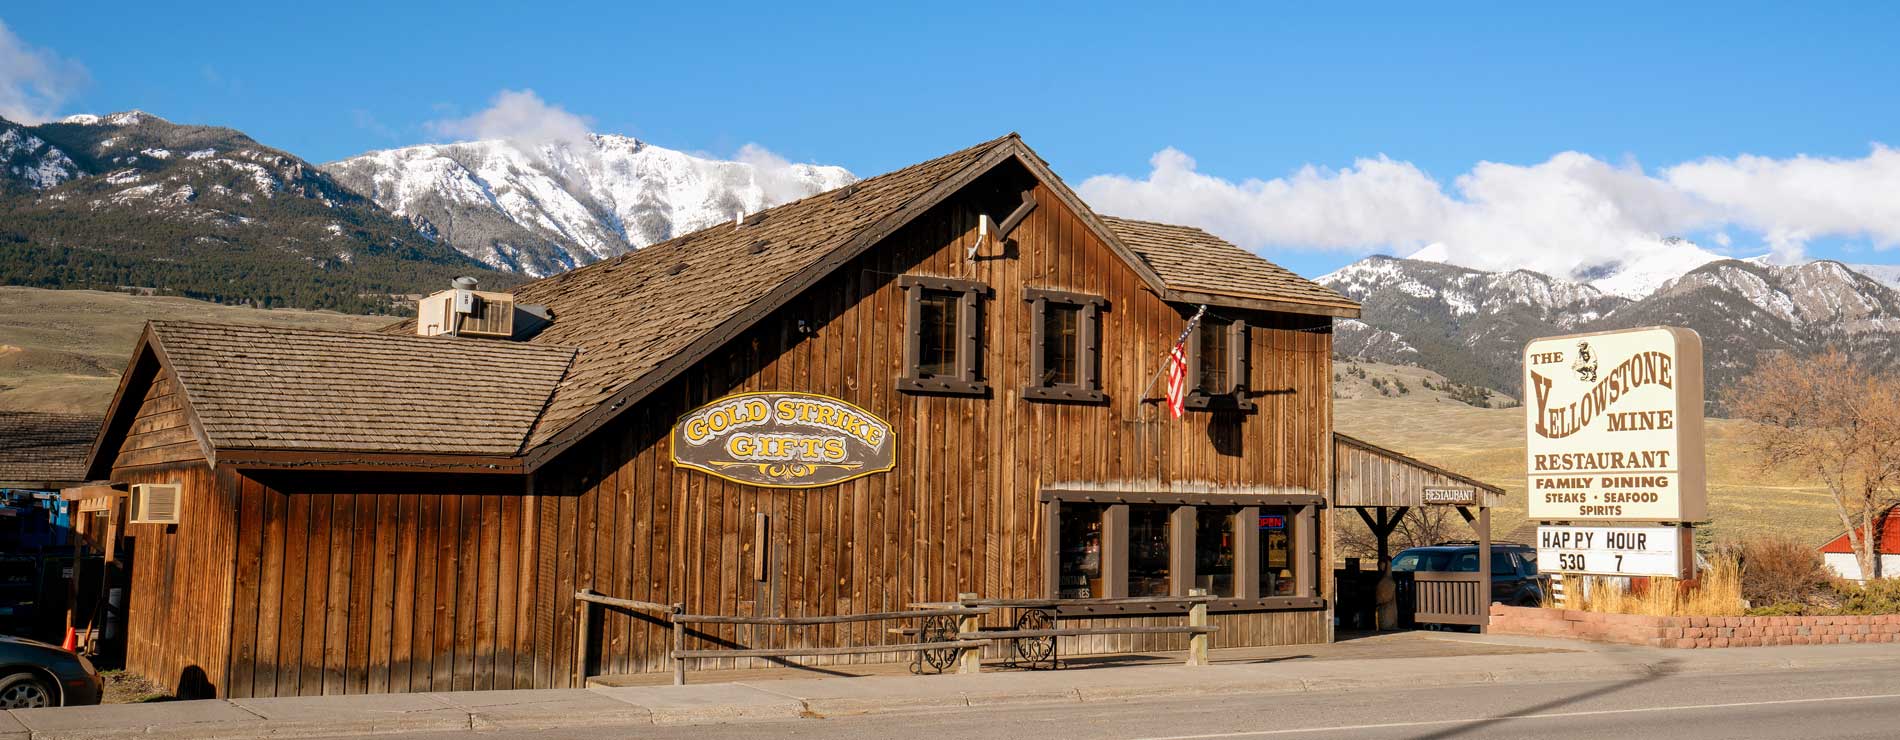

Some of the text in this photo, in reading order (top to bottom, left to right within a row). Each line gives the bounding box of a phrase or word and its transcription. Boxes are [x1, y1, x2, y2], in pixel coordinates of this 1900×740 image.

[1530, 352, 1563, 365] THE
[1530, 351, 1672, 439] YELLOWSTONE
[686, 400, 884, 446] GOLD STRIKE
[1606, 410, 1673, 432] MINE
[729, 436, 844, 459] GIFTS
[1534, 450, 1670, 471] RESTAURANT
[1535, 476, 1669, 490] FAMILY DINING
[1425, 488, 1474, 501] RESTAURANT
[1545, 492, 1659, 504] STEAKS SEAFOOD
[1579, 505, 1622, 516] SPIRITS
[1542, 531, 1647, 550] HAPPY HOUR
[1559, 554, 1624, 572] 530 7
[1060, 575, 1088, 586] ONTANA
